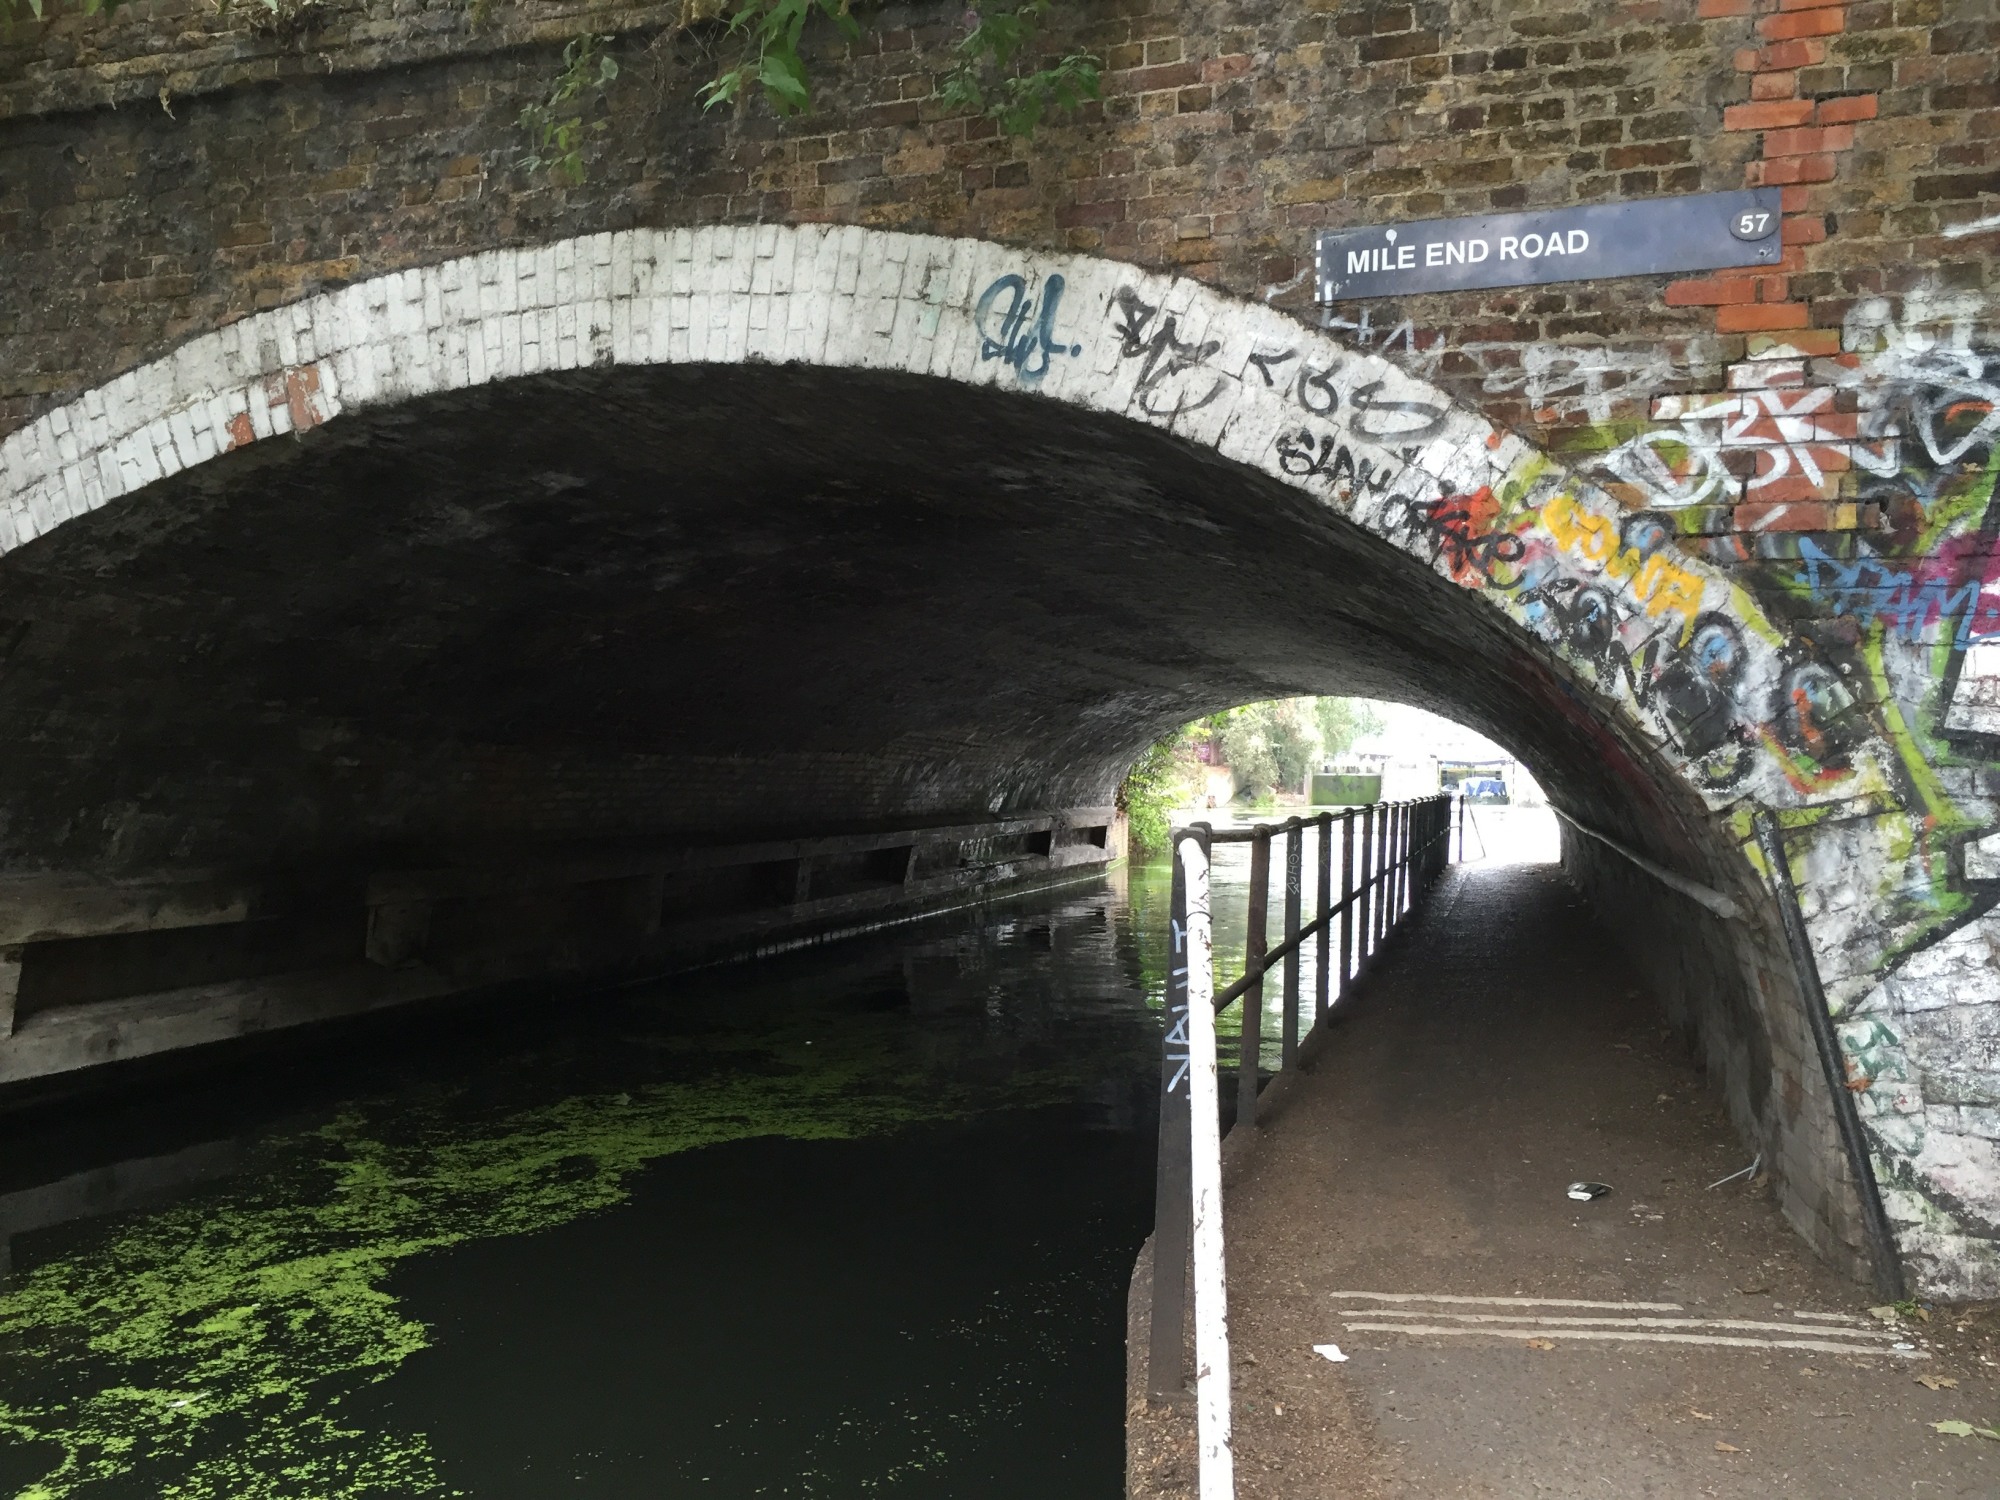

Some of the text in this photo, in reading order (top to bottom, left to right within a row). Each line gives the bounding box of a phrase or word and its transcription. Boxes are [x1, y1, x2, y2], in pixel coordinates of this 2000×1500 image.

[1739, 213, 1770, 234] 57
[1347, 229, 1590, 274] MILE END ROAD
